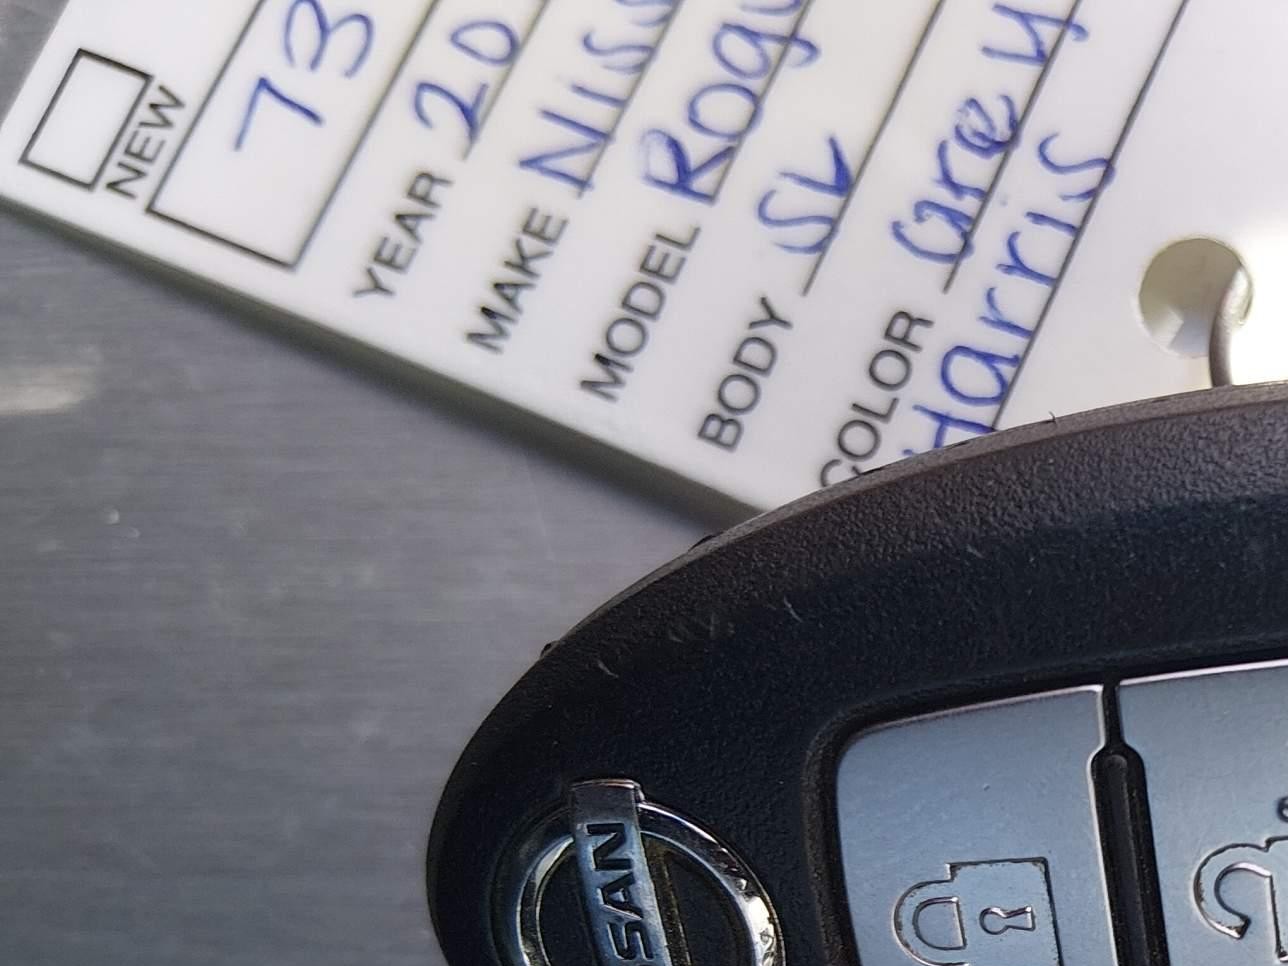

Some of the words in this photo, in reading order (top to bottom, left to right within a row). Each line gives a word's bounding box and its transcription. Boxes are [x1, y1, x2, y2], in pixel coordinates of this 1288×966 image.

[105, 84, 187, 199] NEW
[413, 20, 520, 144] 20
[353, 170, 455, 299] YEAR
[467, 207, 570, 355] MAKE
[580, 226, 700, 402] MODEL
[699, 297, 794, 453] BODY
[820, 310, 934, 488] COLOR
